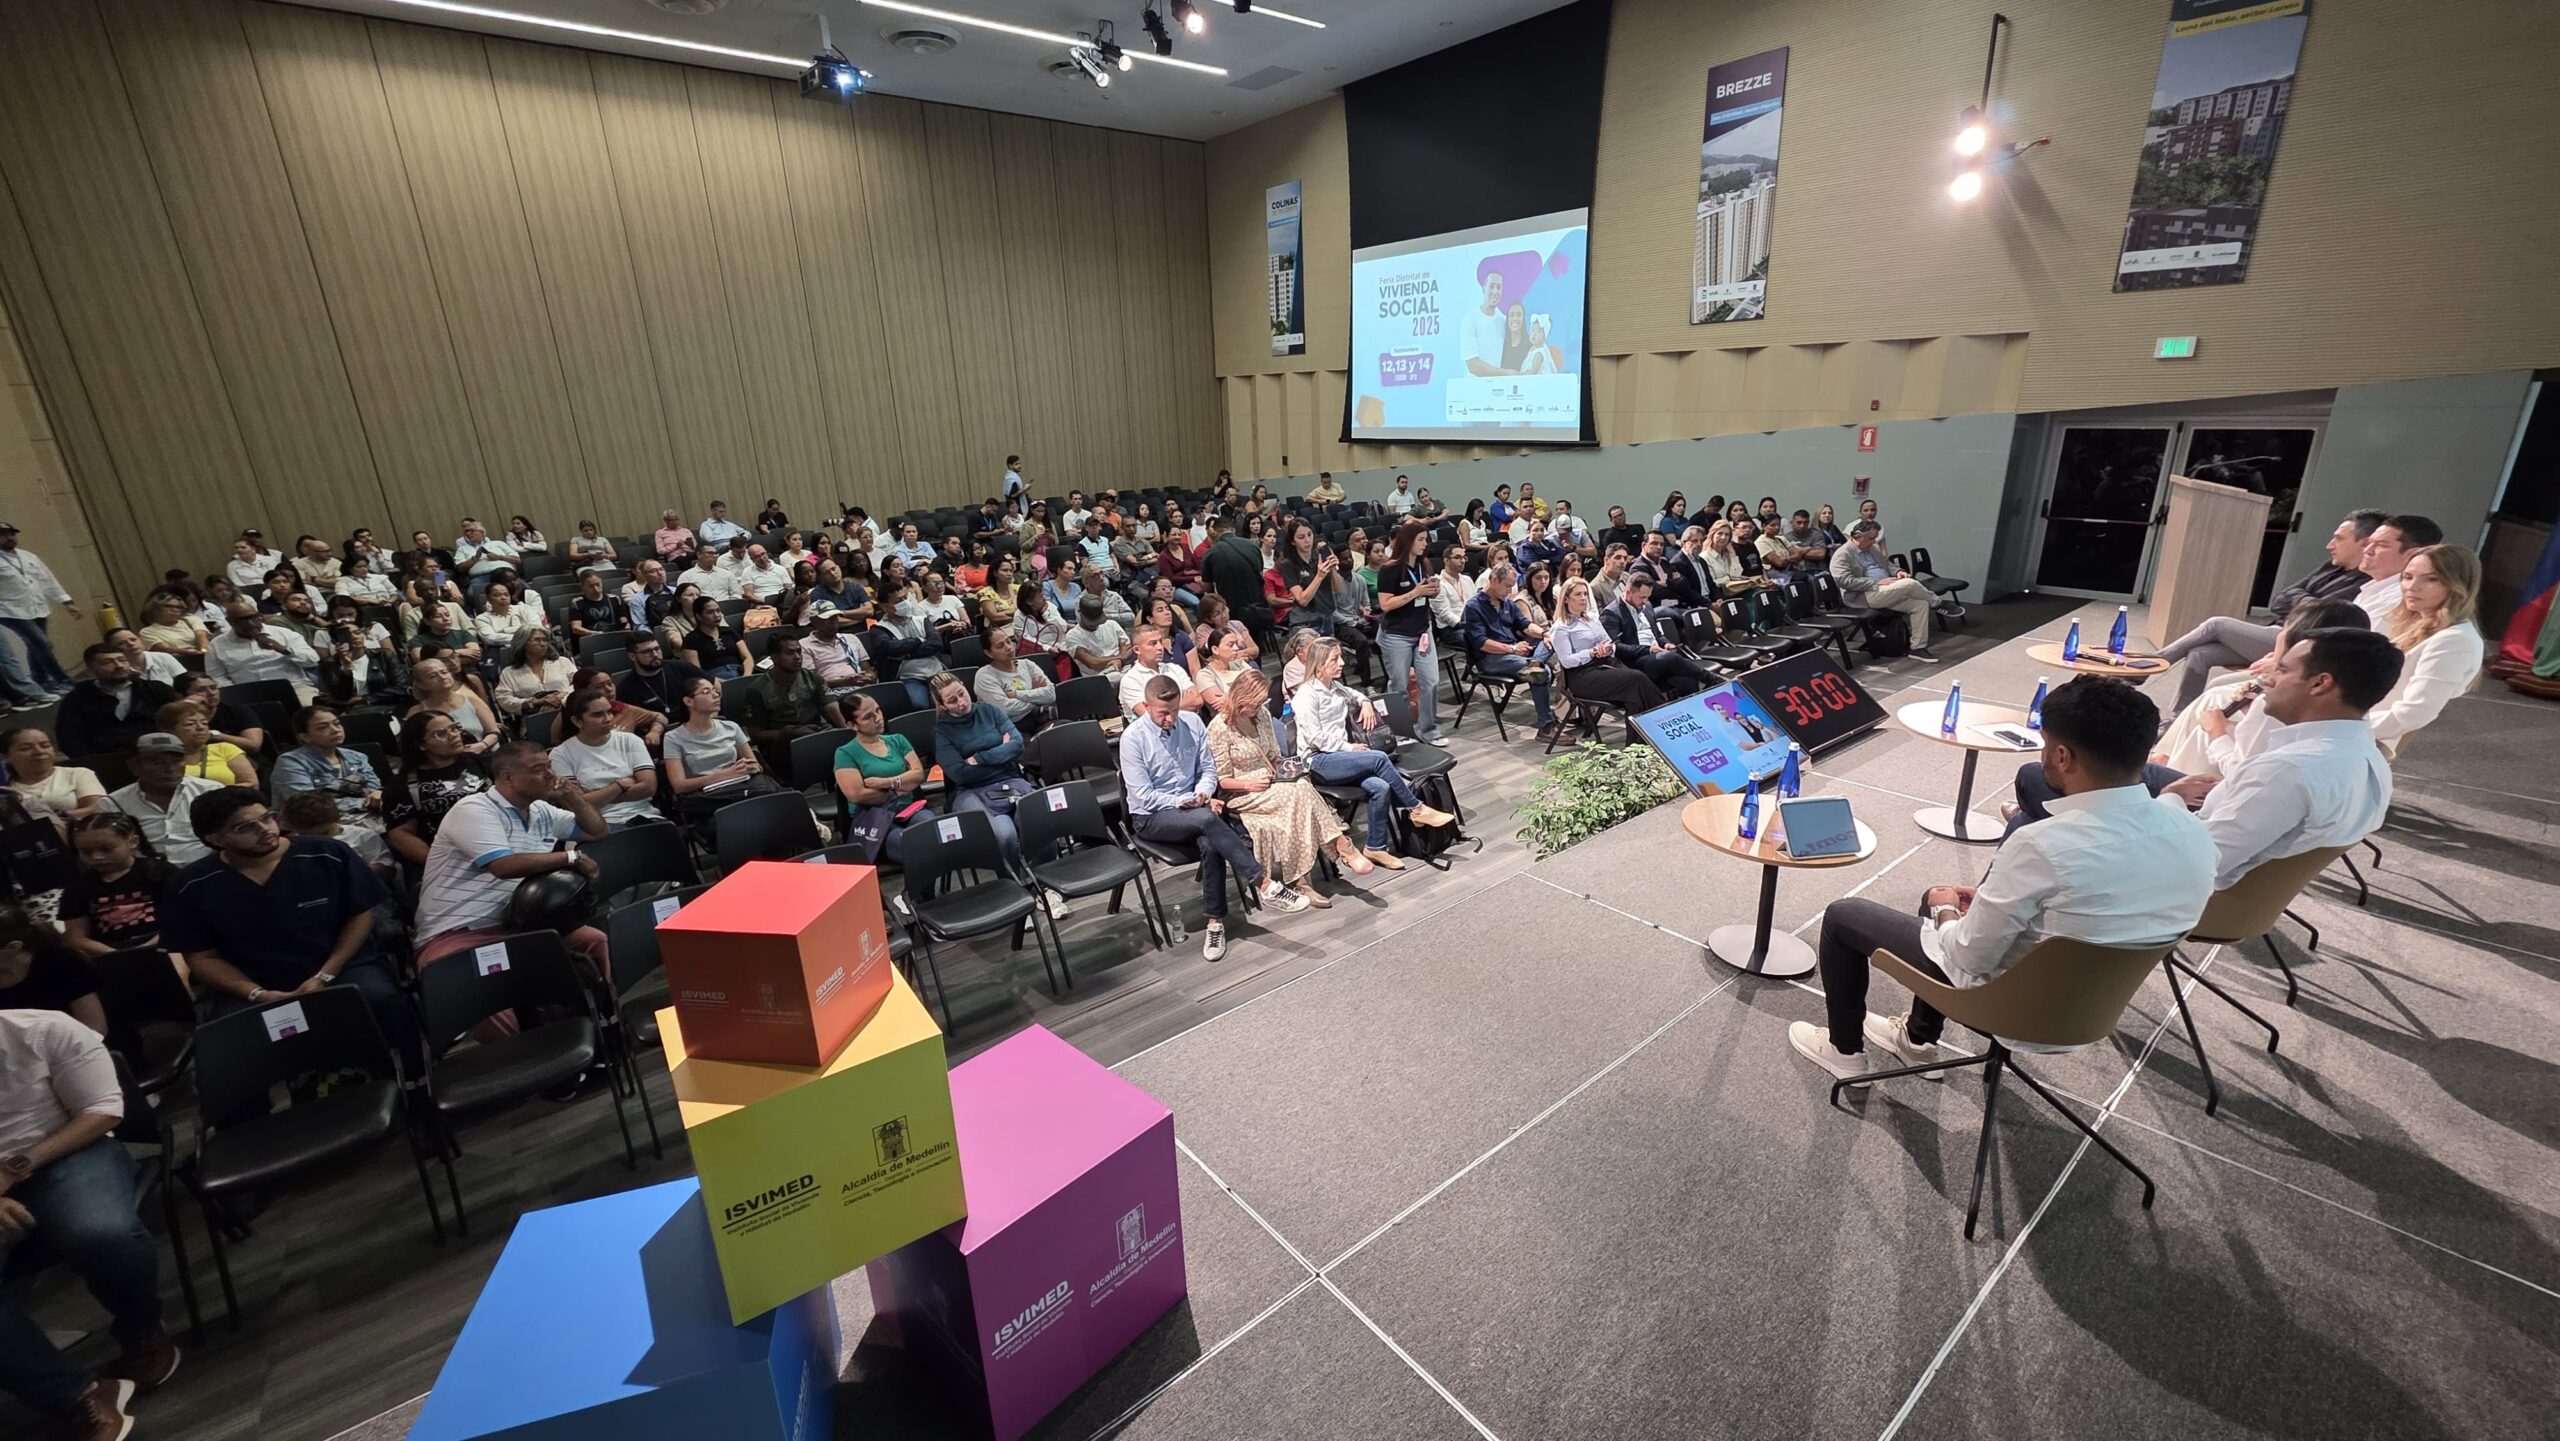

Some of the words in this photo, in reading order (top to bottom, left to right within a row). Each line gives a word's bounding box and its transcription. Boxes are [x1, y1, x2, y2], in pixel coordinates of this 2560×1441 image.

[1716, 72, 1773, 99] BREZZE
[1271, 196, 1298, 210] COLINAS
[1379, 279, 1439, 299] VIVIENDA
[1379, 295, 1440, 318] SOCIAL
[1412, 315, 1440, 336] 2025
[1382, 359, 1407, 373] 12,13
[1408, 360, 1416, 374] y
[1417, 357, 1431, 371] 14
[1774, 672, 1857, 726] 30:00
[1657, 713, 1695, 731] VIVIENDA
[1665, 721, 1703, 740] SOCIAL
[816, 966, 843, 998] ISVIMED
[681, 990, 727, 1000] ISVIMED
[889, 1161, 903, 1173] de
[725, 1174, 814, 1221] ISVIMED
[1127, 1251, 1140, 1264] de
[994, 1280, 1069, 1347] ISVIMED
[793, 1359, 807, 1441] SVIMED
